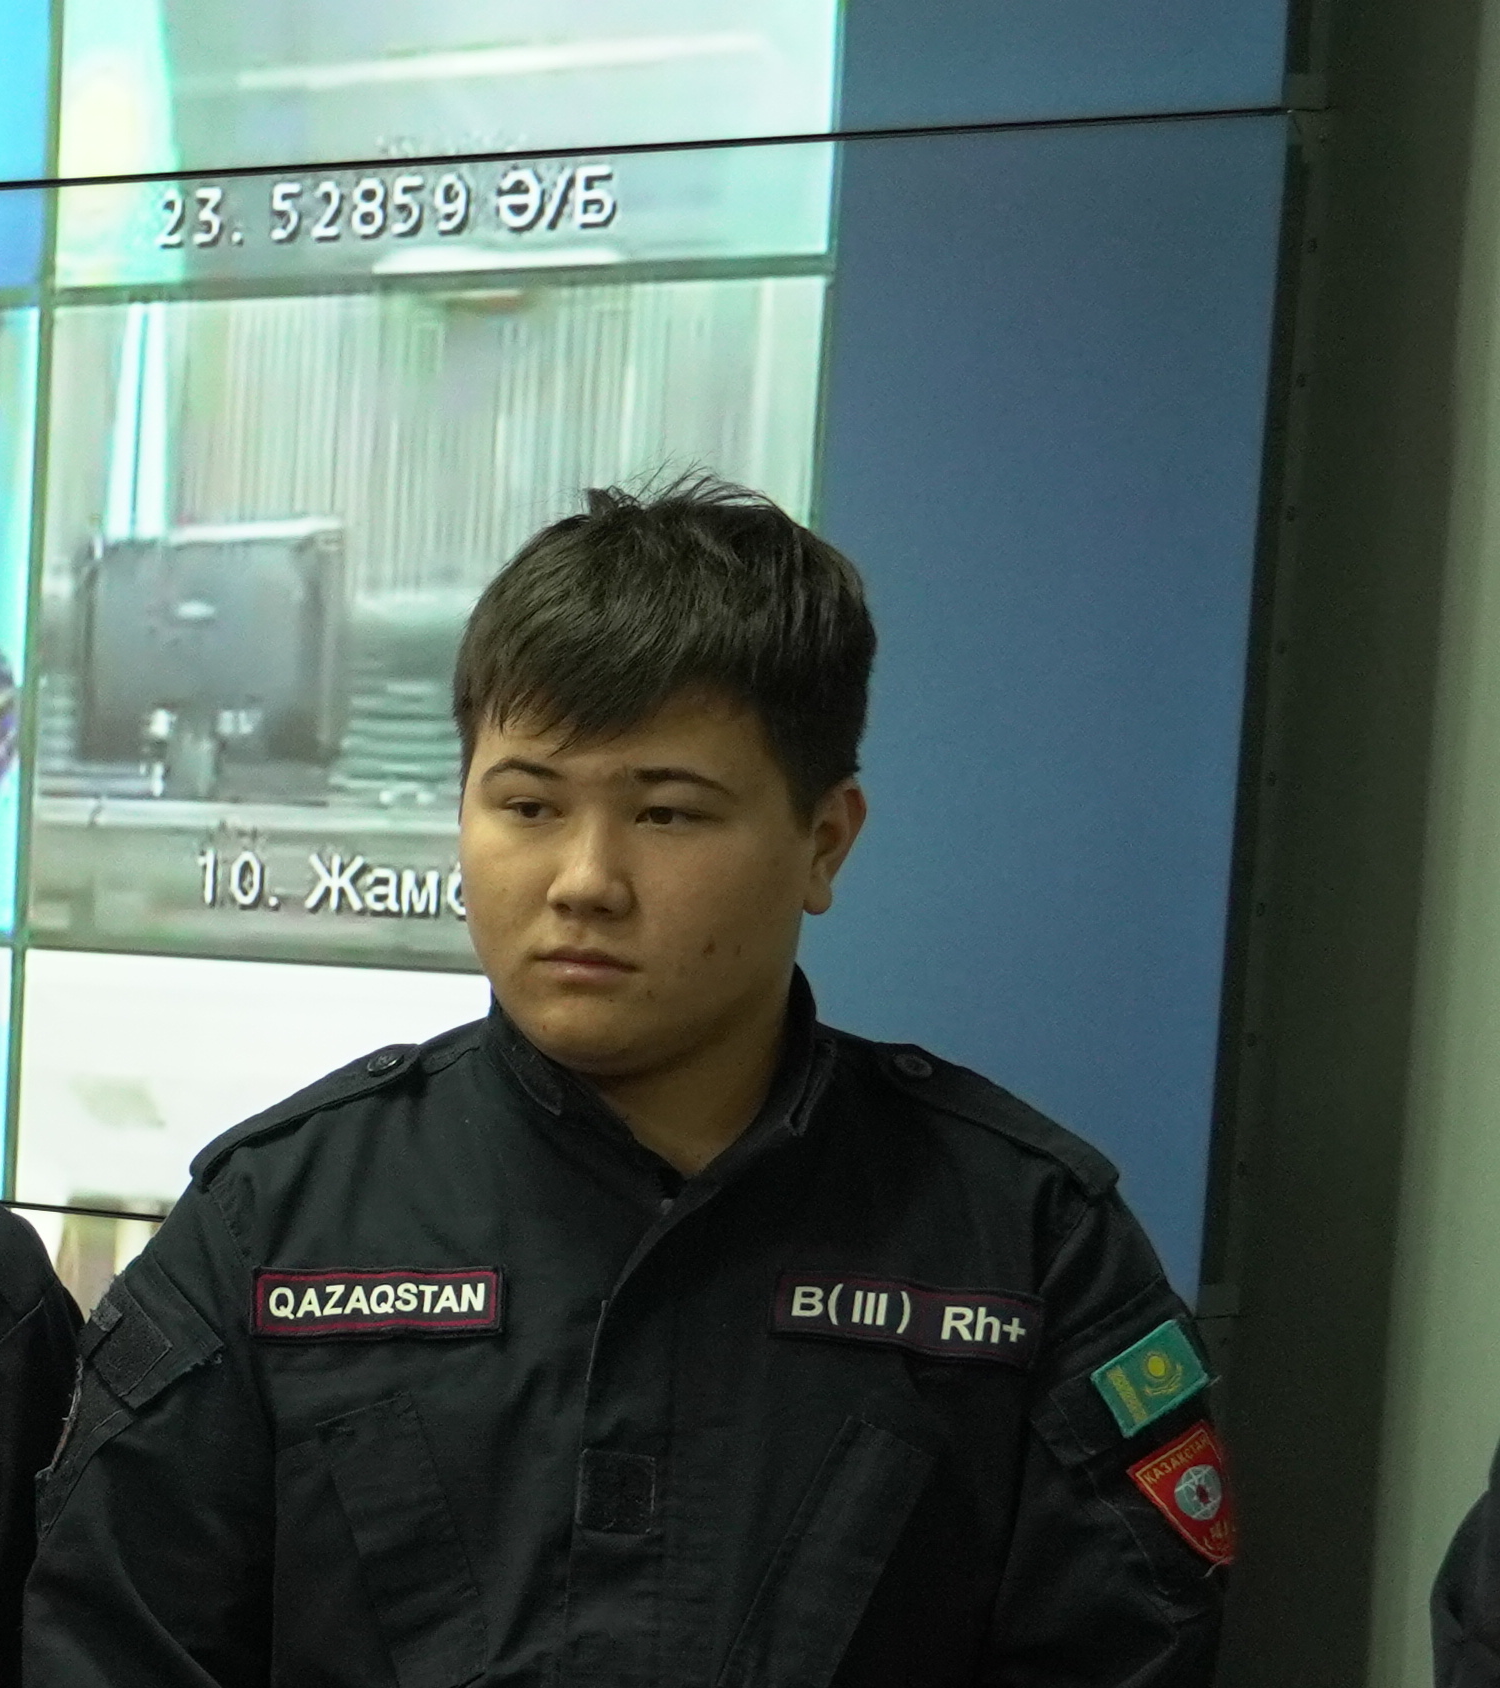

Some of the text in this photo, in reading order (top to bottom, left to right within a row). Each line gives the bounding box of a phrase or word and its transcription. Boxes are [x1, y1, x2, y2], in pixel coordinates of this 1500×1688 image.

[159, 186, 245, 249] 23.
[270, 176, 471, 244] 52859
[199, 848, 280, 910] 10.
[267, 1281, 486, 1321] QAZAQSTAN
[940, 1305, 1027, 1345] Rh+
